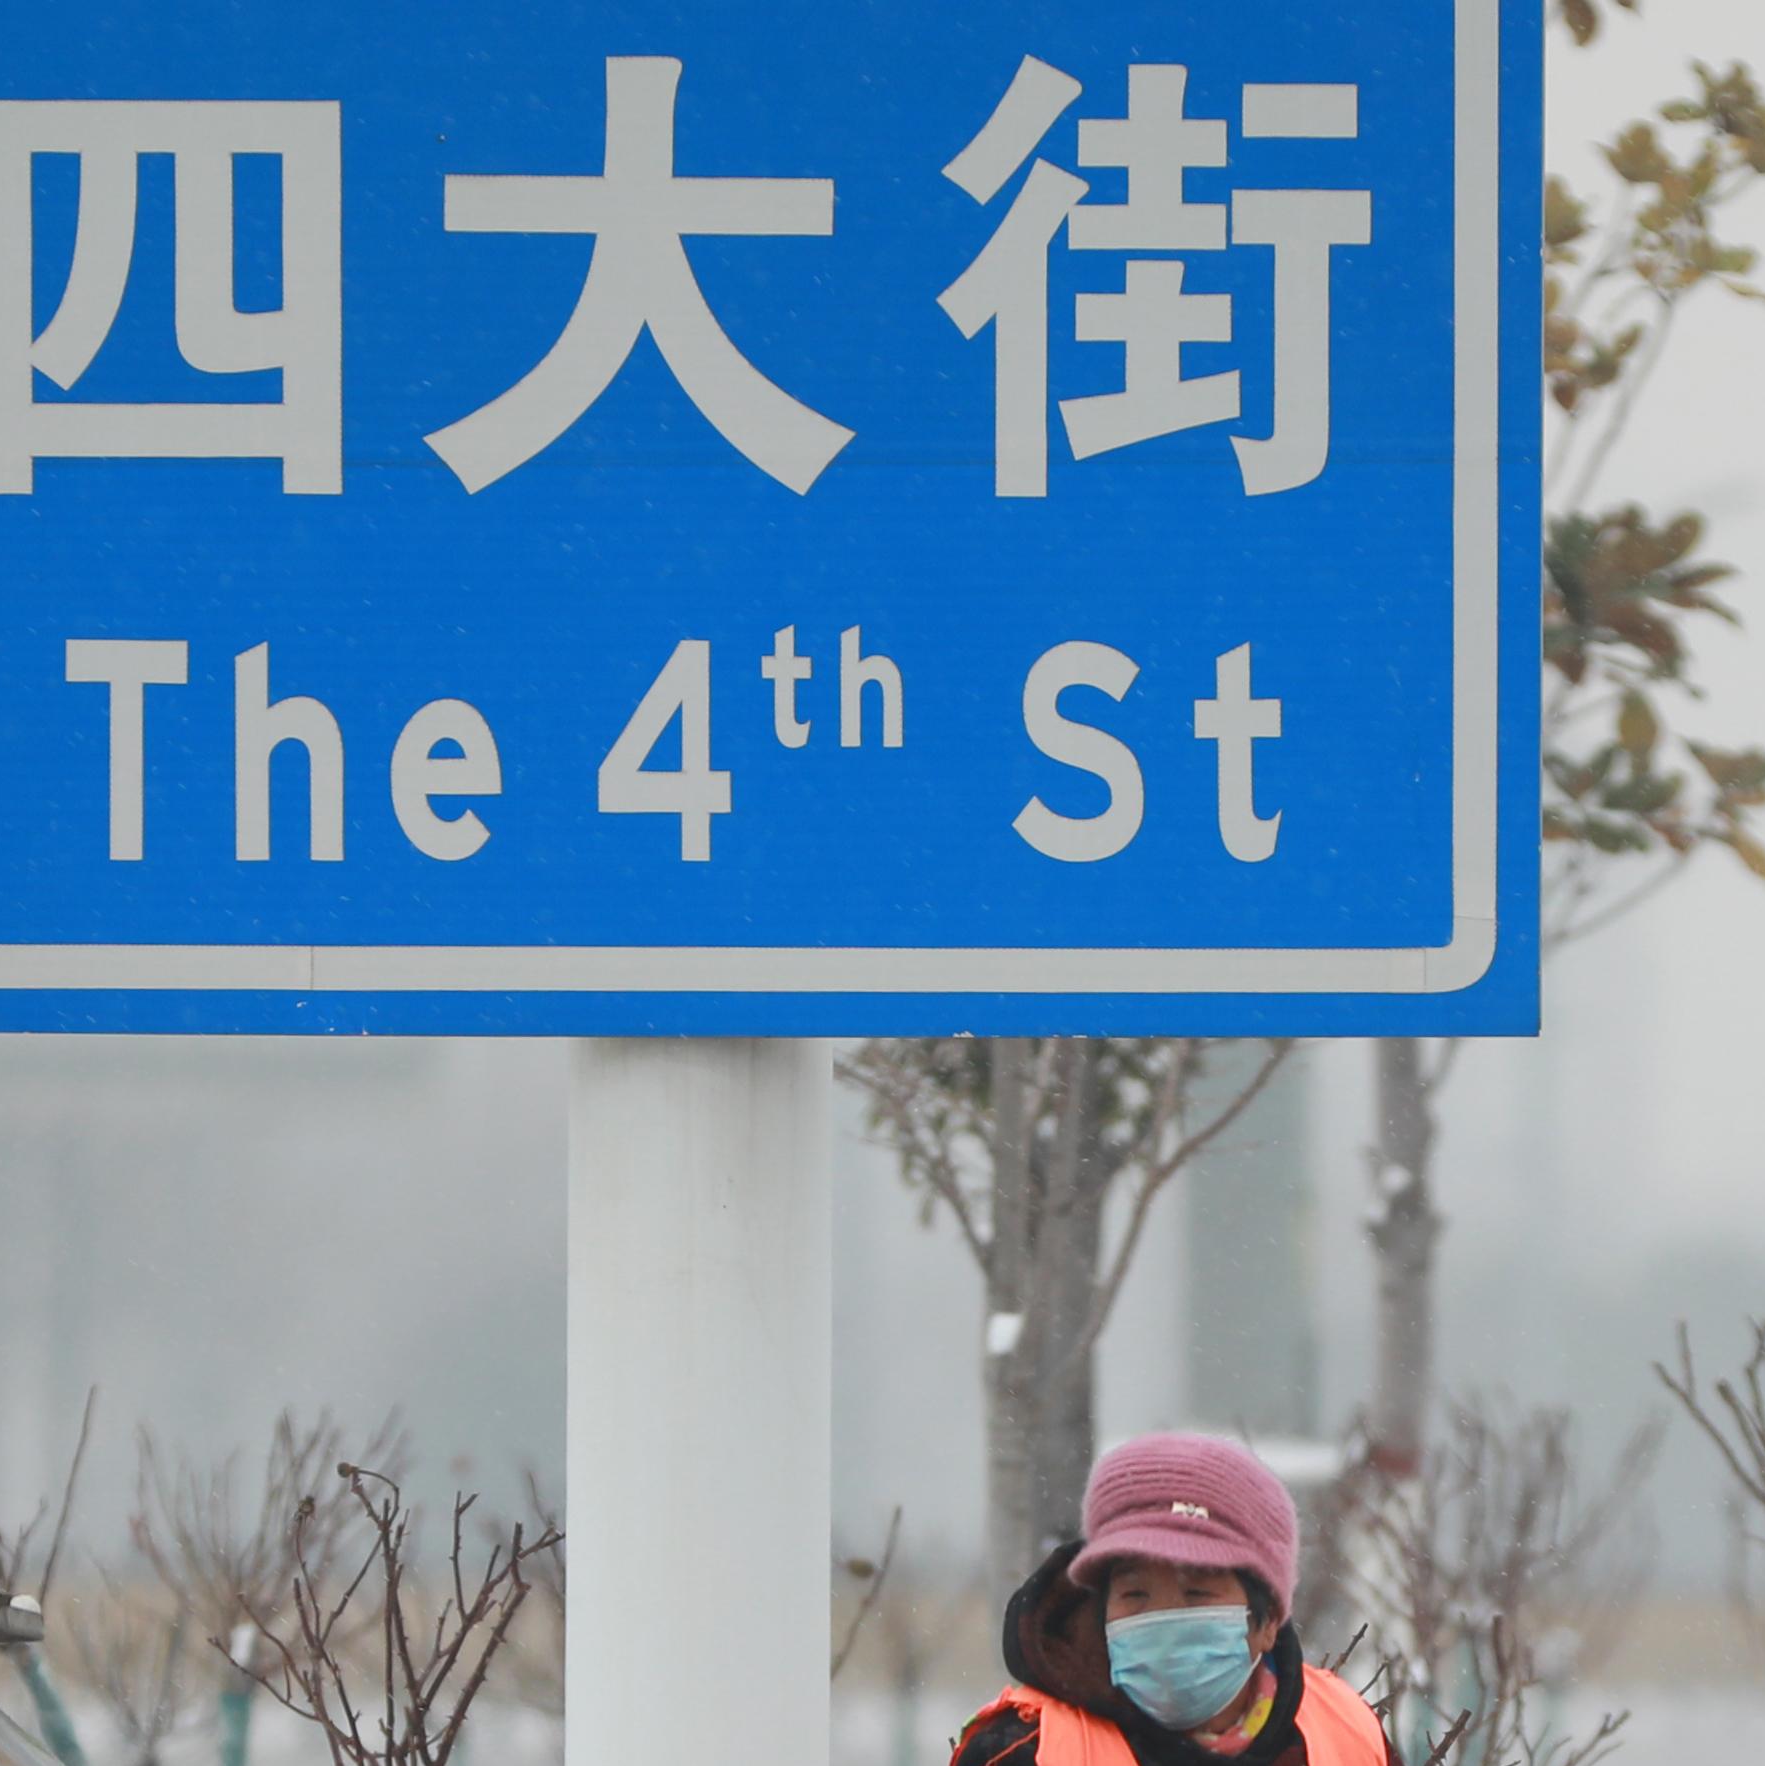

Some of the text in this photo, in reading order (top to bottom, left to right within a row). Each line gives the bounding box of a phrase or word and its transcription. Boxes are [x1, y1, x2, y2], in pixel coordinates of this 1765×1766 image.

[65, 624, 1284, 863] The 4th St
